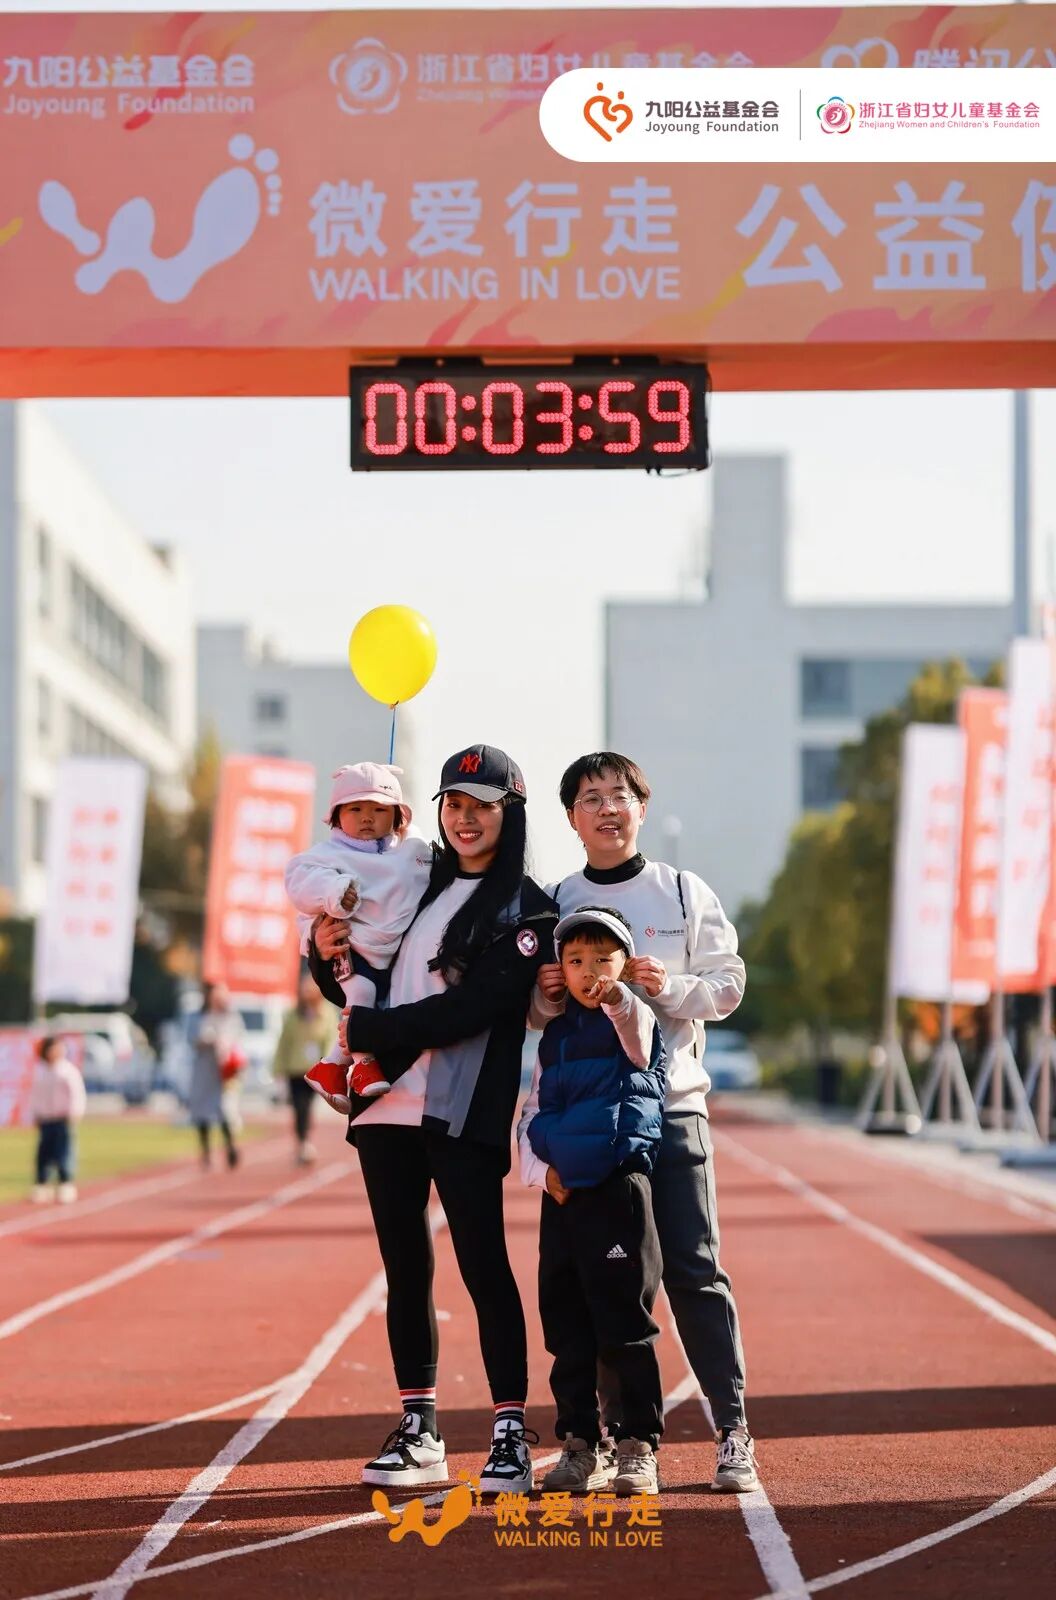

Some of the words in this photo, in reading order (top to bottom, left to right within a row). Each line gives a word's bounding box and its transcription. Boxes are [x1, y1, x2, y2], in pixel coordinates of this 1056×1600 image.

[3, 55, 255, 88] 九阳公益基金会
[4, 94, 106, 119] Joyoung
[117, 92, 255, 114] Foundation
[308, 176, 679, 257] 微爱行走
[309, 267, 499, 300] WALKING
[519, 267, 559, 300] IN
[577, 266, 681, 299] LOVE
[365, 380, 690, 456] 00:03:59
